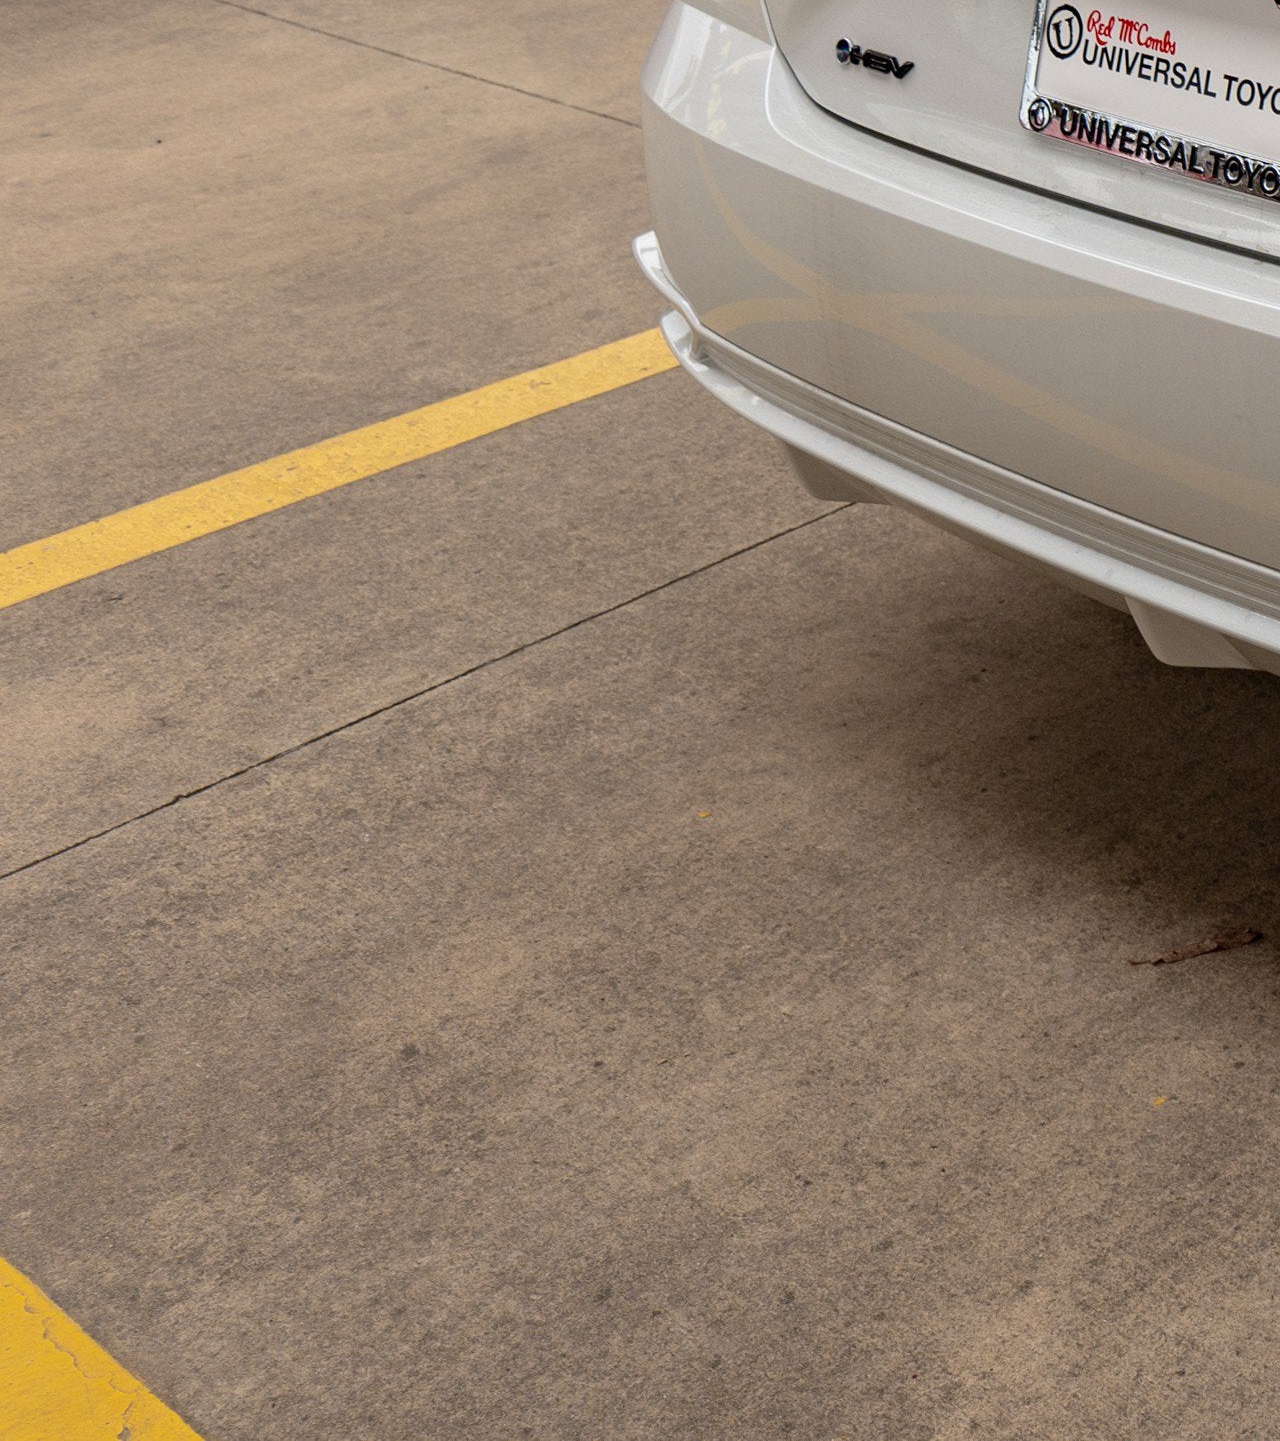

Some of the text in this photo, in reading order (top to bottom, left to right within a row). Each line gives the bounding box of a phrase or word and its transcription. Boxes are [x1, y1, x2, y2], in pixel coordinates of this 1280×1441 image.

[1086, 9, 1178, 56] Red McCombs
[1082, 38, 1217, 99] UNIVERSAL
[1059, 107, 1206, 175] UNIVERSAL
